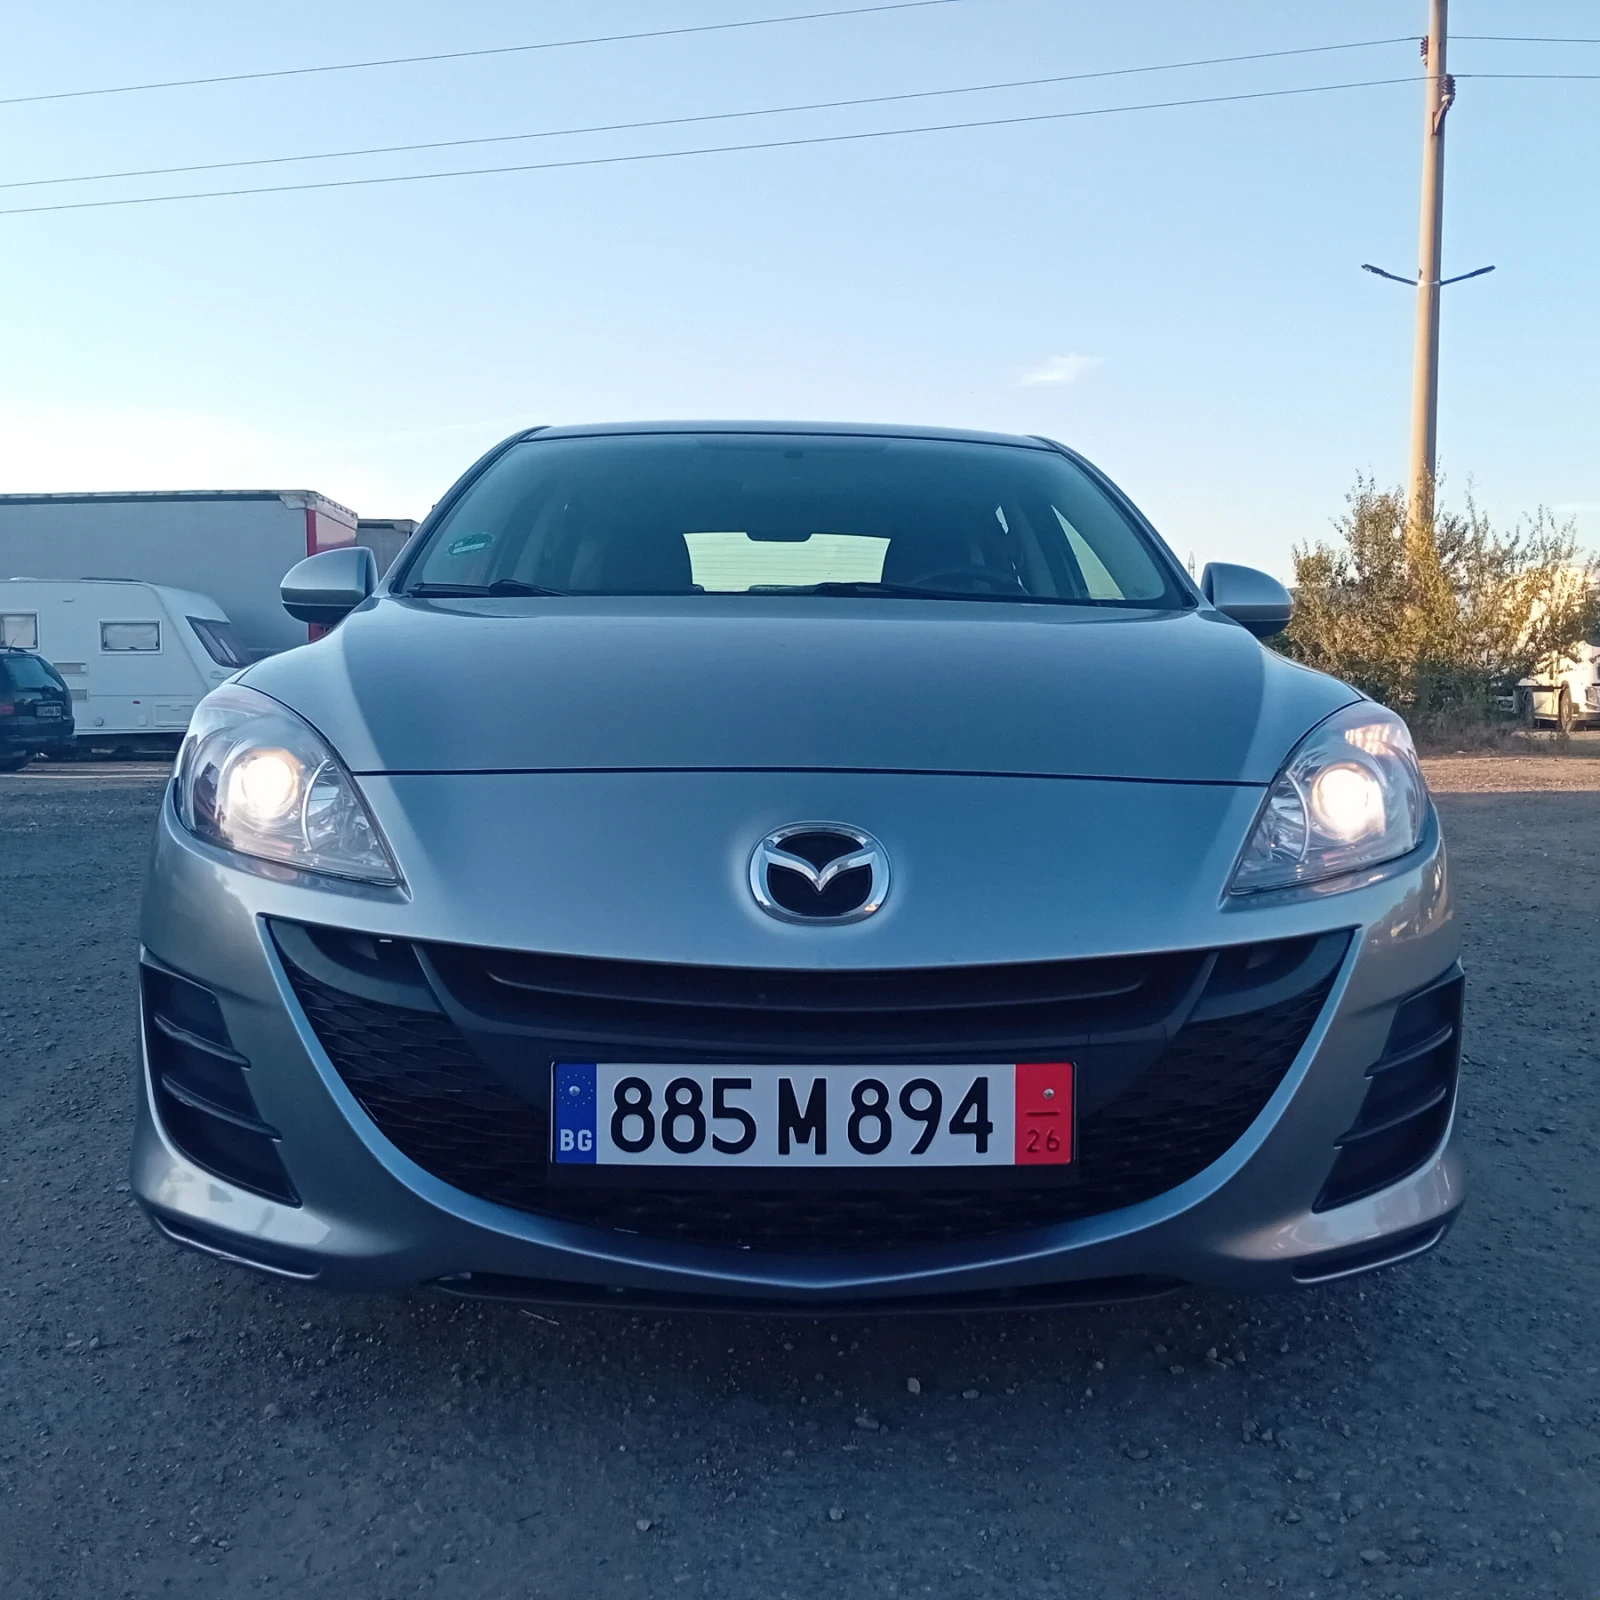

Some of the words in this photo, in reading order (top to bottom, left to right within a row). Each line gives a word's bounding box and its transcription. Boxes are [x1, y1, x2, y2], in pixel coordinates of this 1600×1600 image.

[610, 1076, 757, 1155] 885
[777, 1077, 828, 1156] M
[847, 1076, 994, 1156] 894
[560, 1128, 593, 1152] BG
[1026, 1127, 1061, 1153] 26
